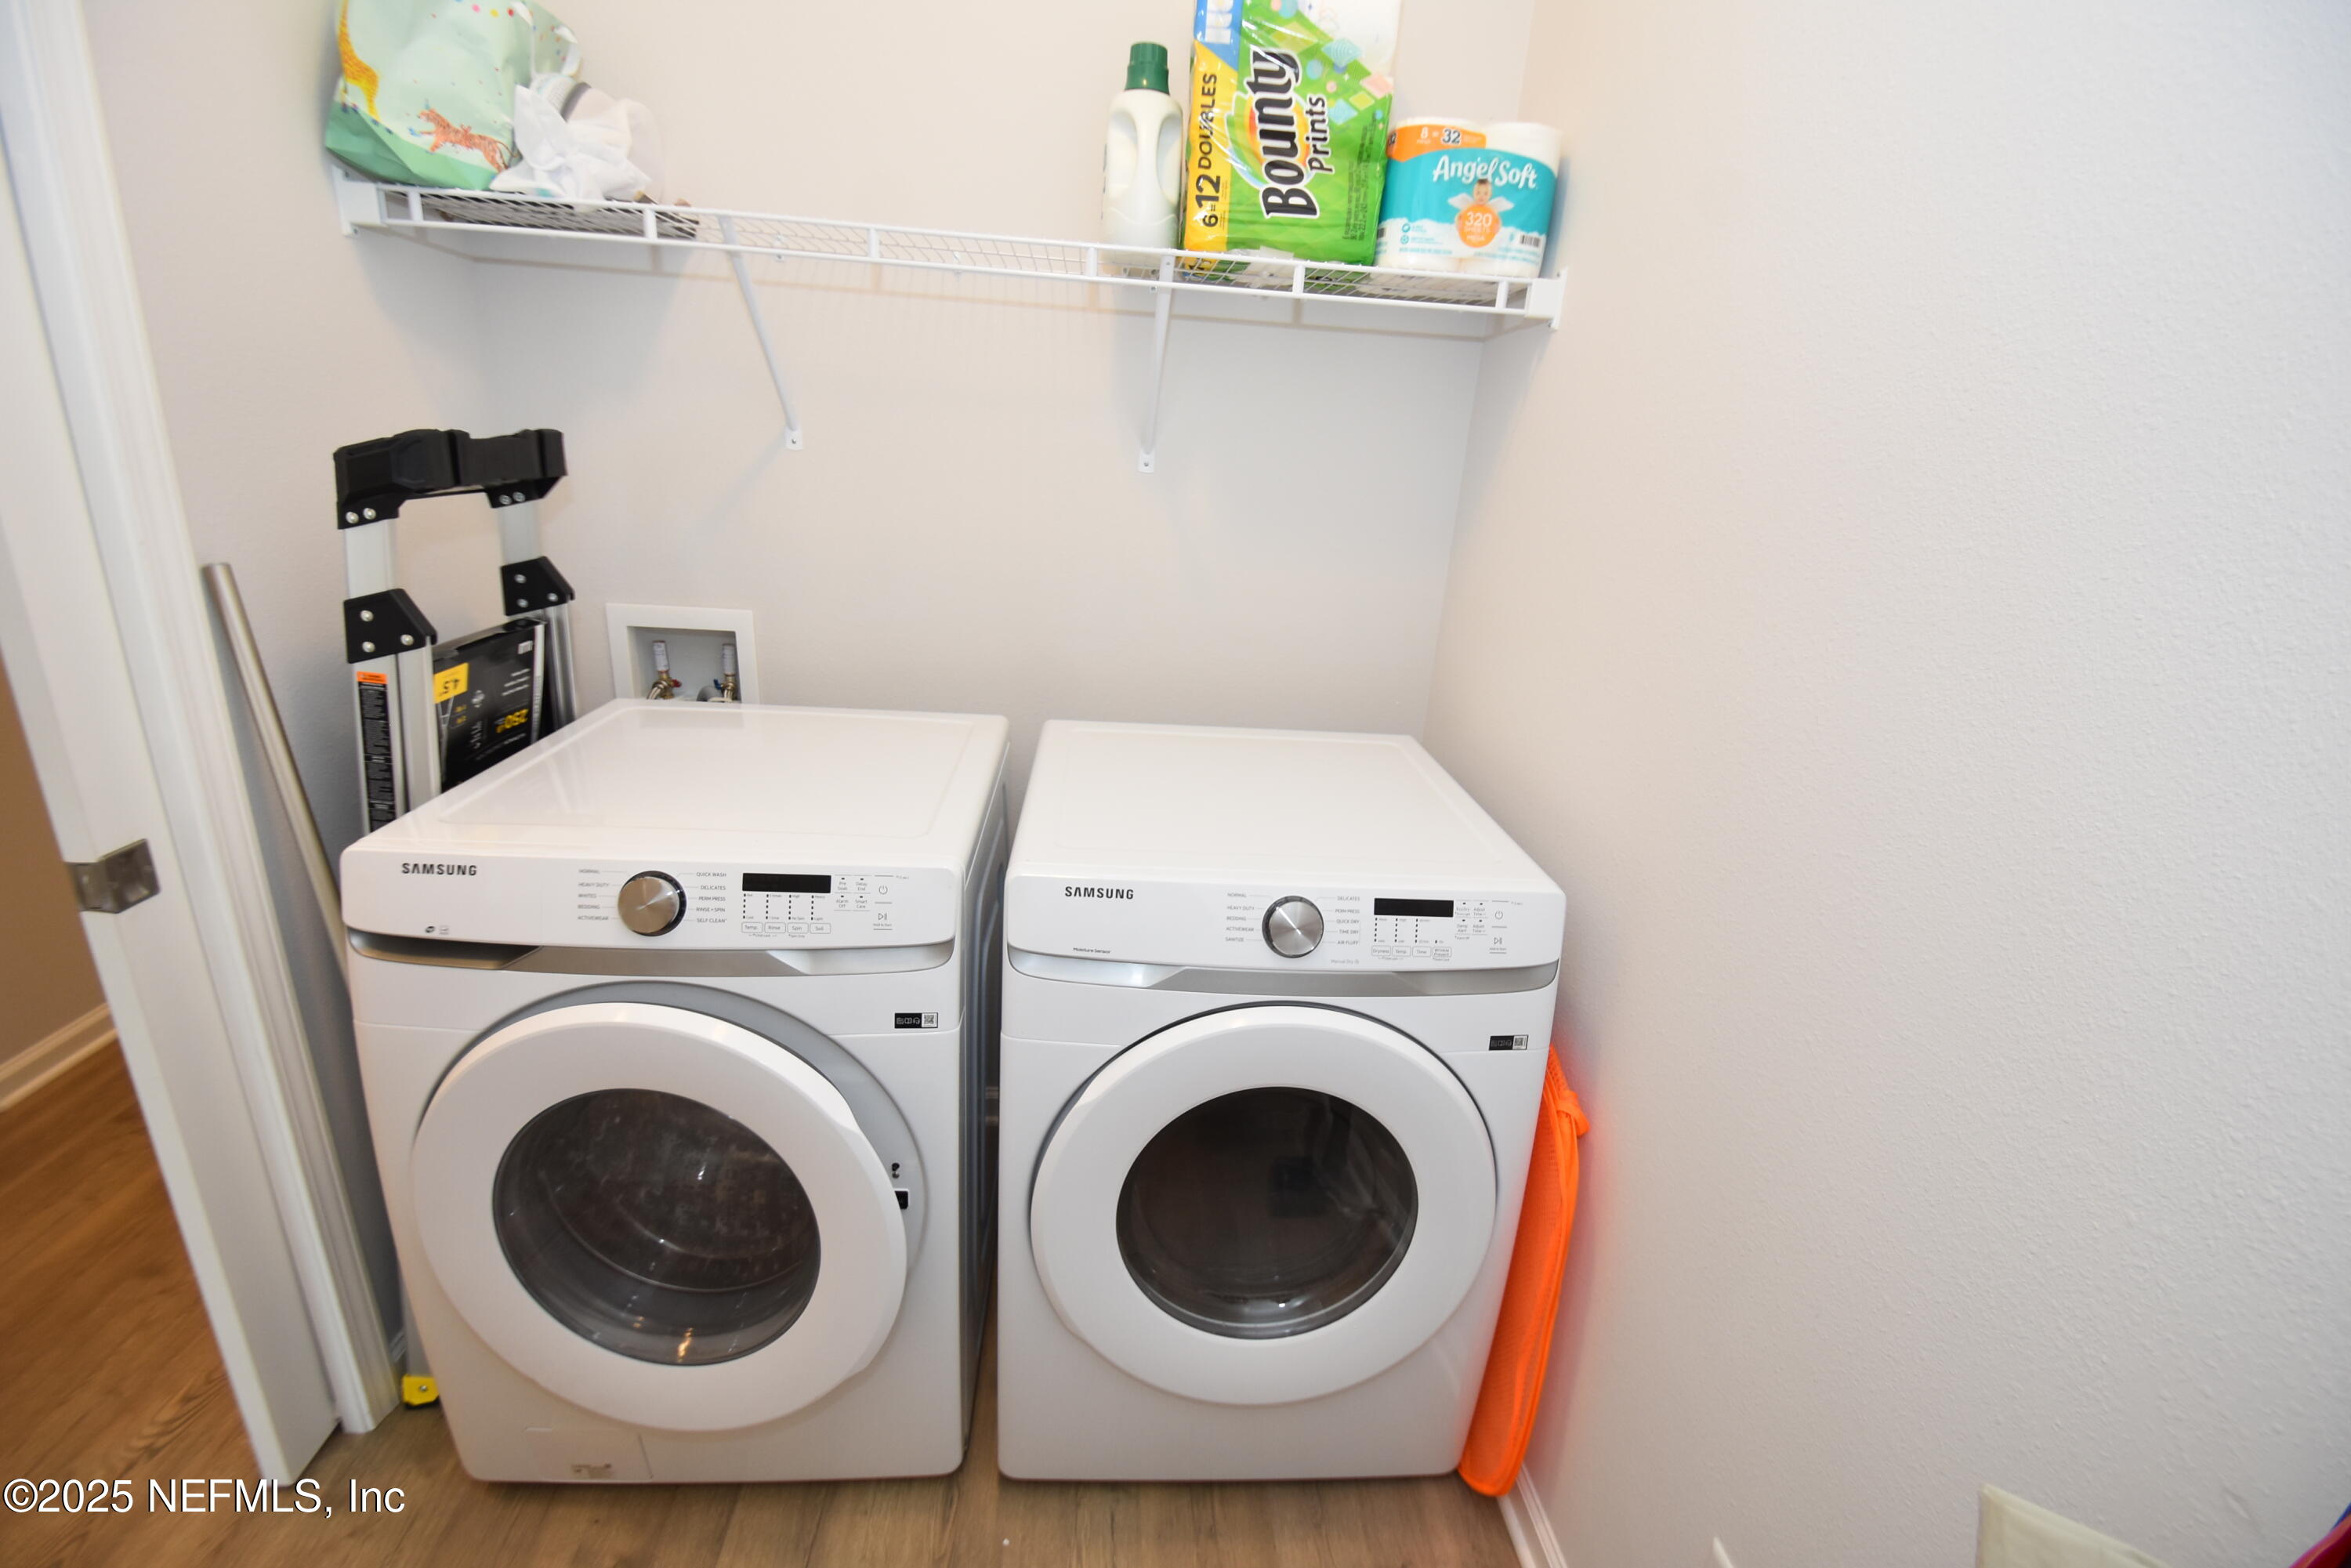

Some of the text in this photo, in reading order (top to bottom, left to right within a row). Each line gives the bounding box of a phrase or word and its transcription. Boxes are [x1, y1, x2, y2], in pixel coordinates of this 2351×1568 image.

[1246, 49, 1318, 216] Bounty
[1306, 96, 1334, 172] Prints
[1442, 128, 1462, 145] 32
[1433, 154, 1538, 190] Angel Soft
[1465, 211, 1492, 226] 320
[402, 862, 477, 876] SAMSUNG
[1064, 886, 1134, 900] SAMSUNG
